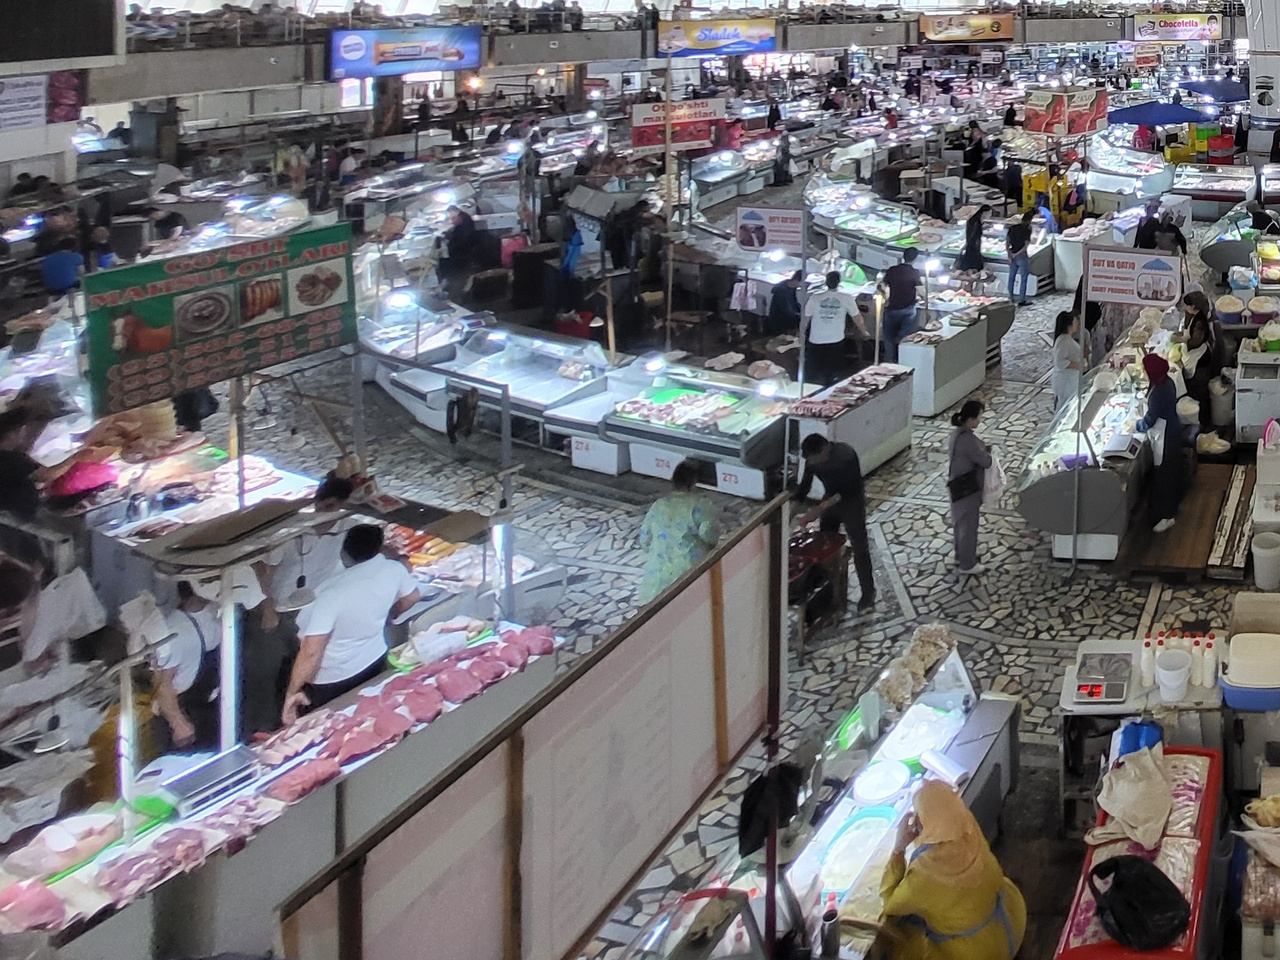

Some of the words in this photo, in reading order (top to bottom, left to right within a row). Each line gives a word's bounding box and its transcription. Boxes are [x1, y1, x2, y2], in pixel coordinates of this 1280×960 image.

[1159, 20, 1198, 28] Chocotella
[696, 27, 741, 41] Sladek
[575, 441, 589, 451] 274
[722, 473, 738, 484] 273
